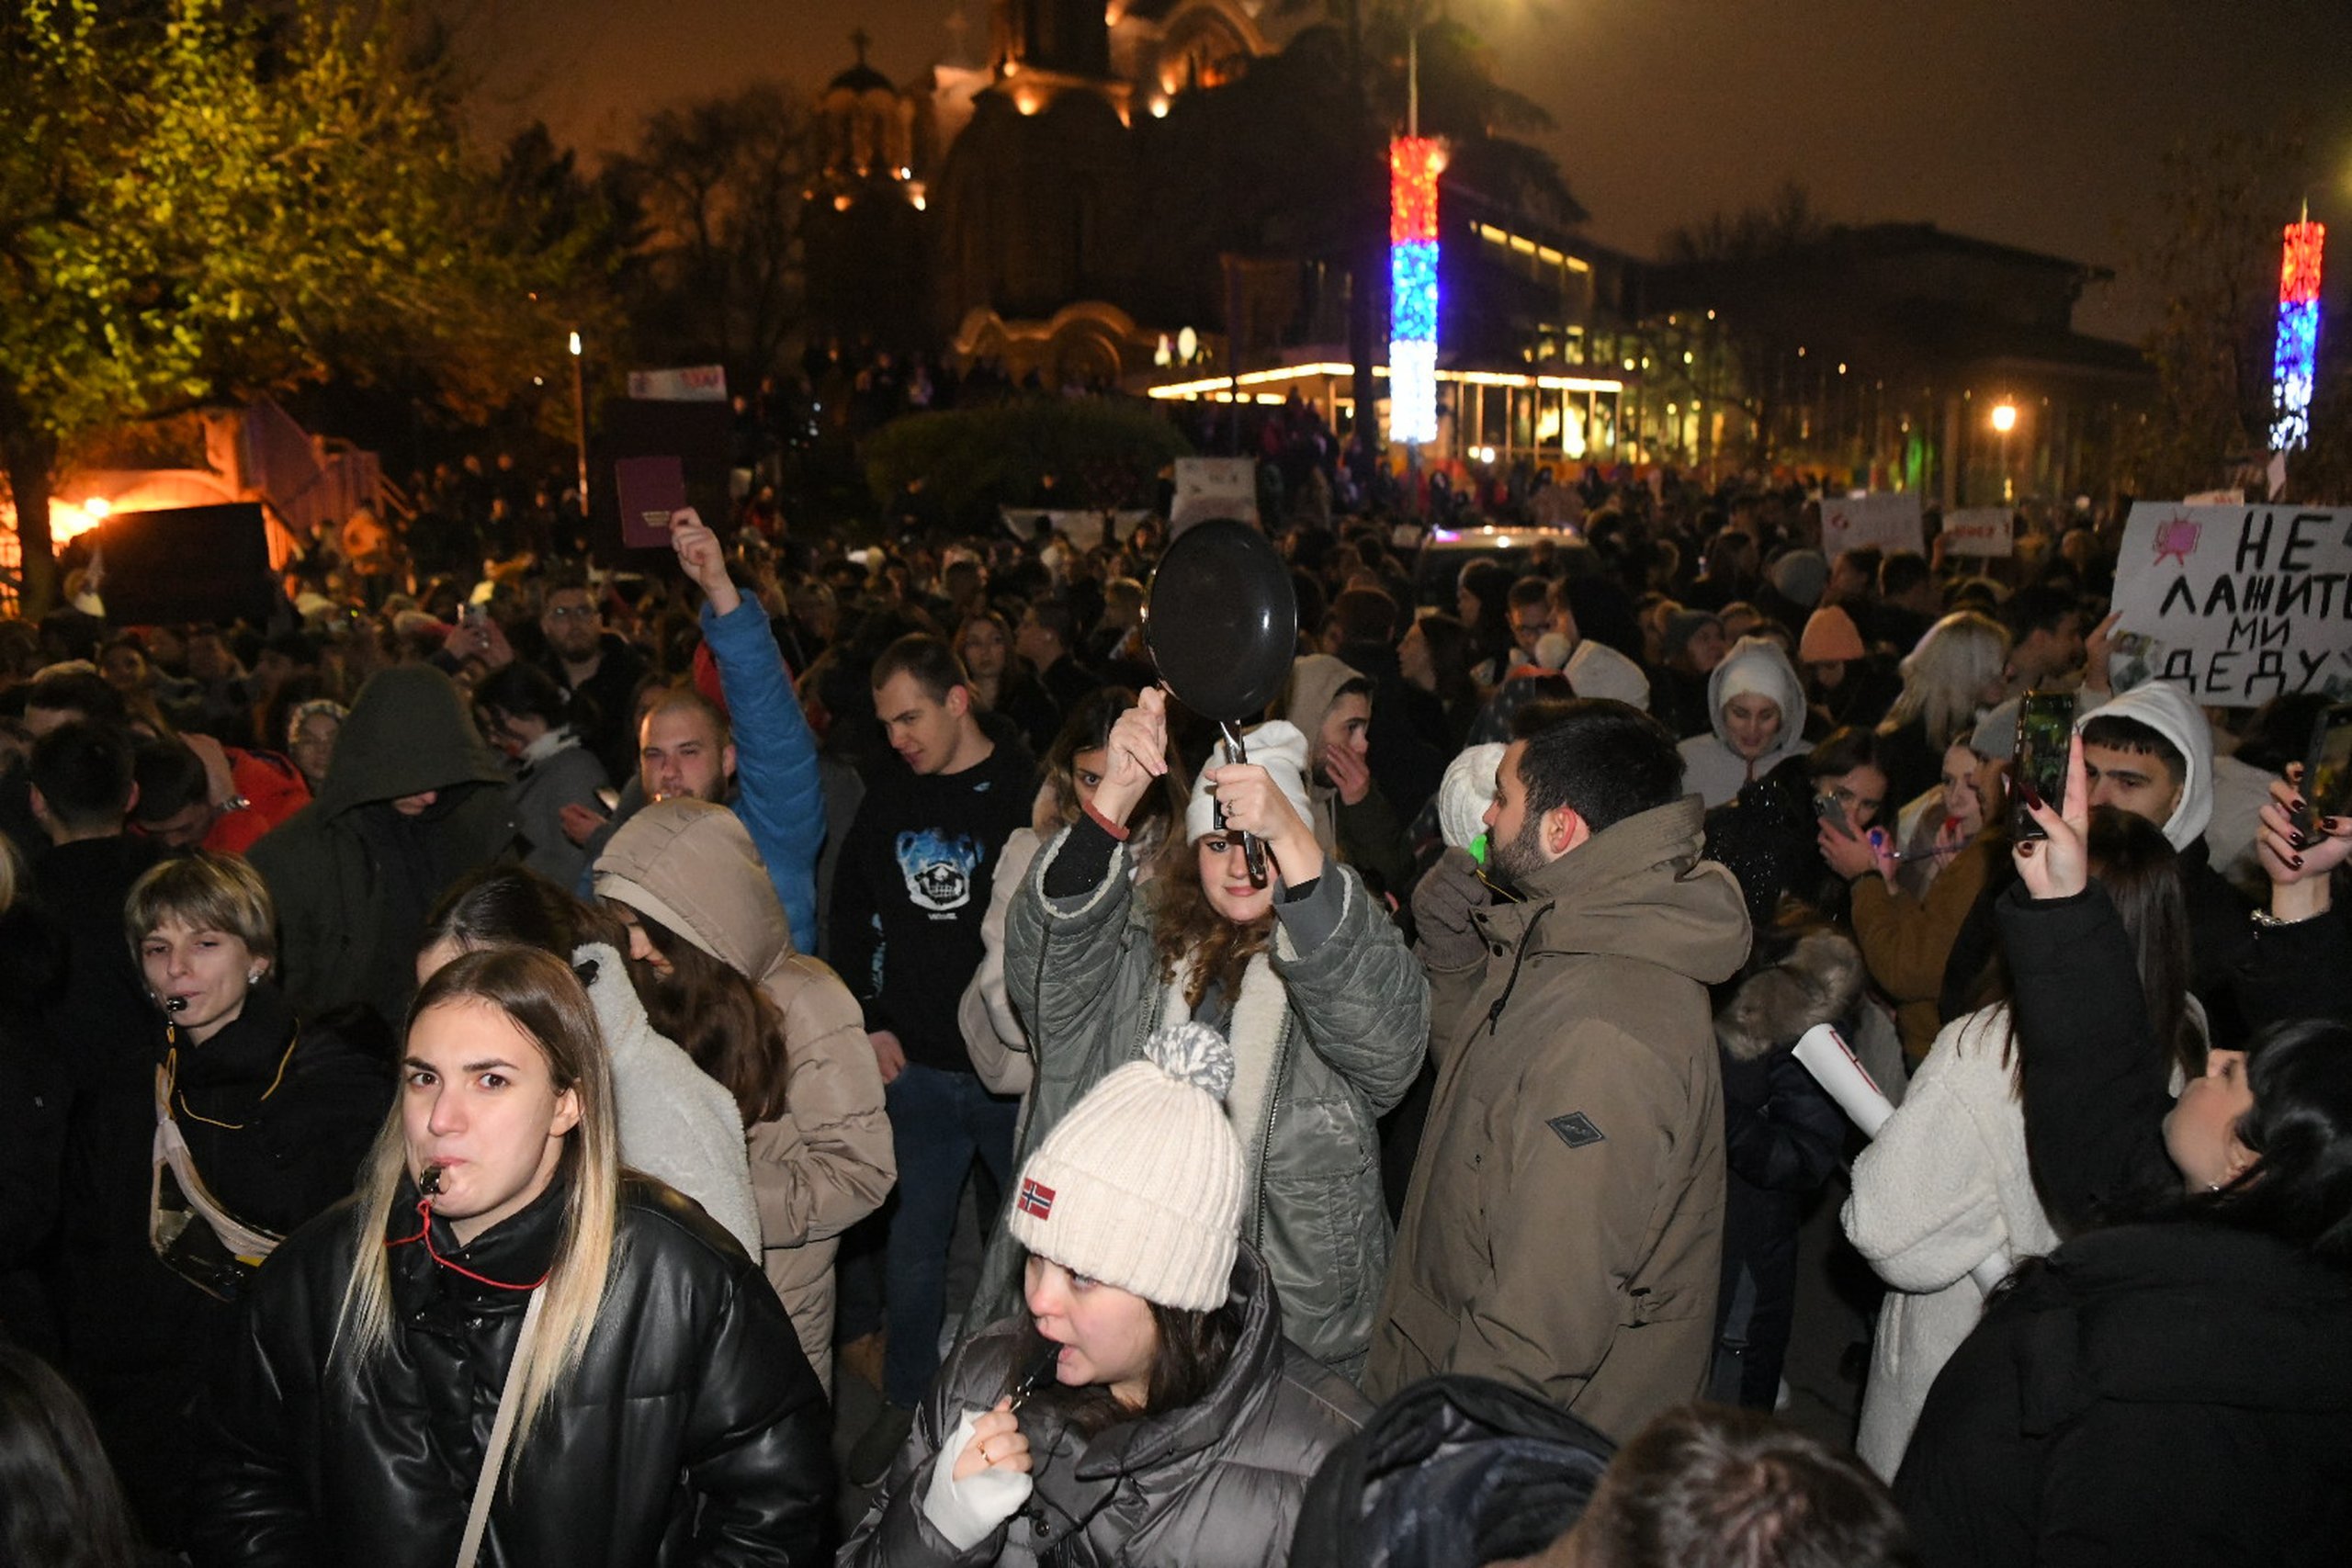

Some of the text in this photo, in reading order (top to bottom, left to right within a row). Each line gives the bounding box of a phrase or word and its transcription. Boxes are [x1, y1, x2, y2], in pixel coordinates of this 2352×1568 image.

[2236, 511, 2333, 573] НЕ
[2227, 616, 2290, 650] МИ
[2154, 648, 2331, 699] ДЕДУ
